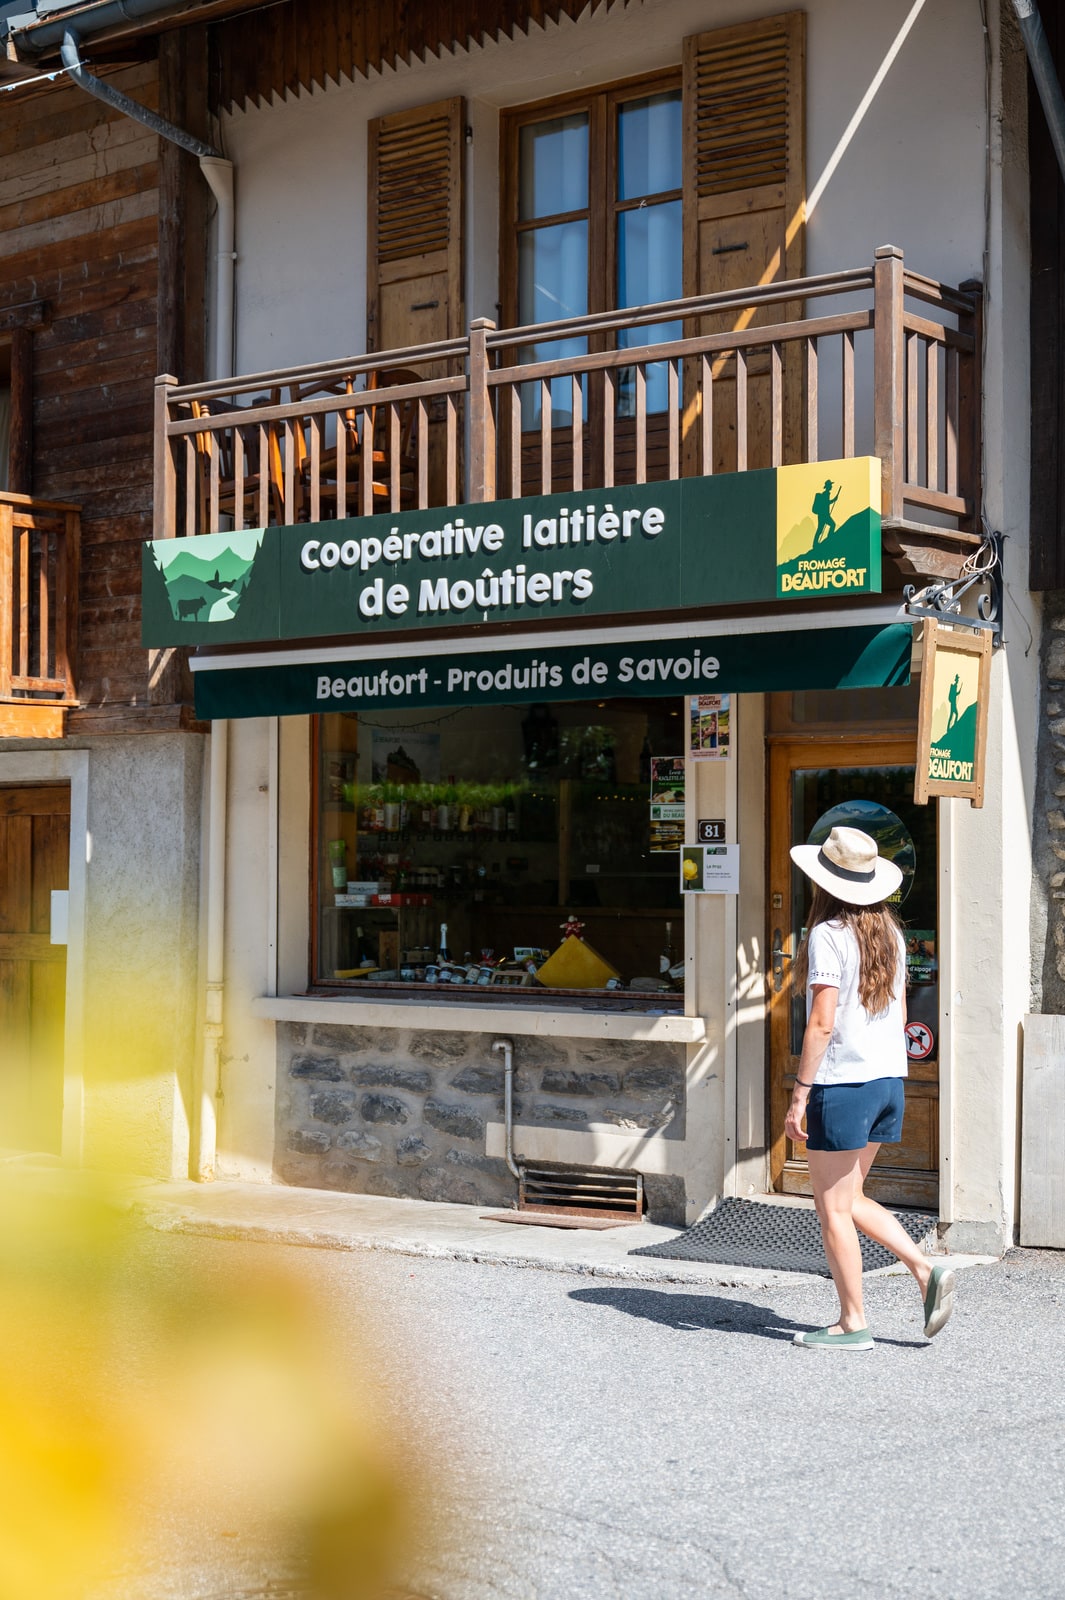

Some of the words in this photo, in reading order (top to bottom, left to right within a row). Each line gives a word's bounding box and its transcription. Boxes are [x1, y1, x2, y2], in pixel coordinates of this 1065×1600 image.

[301, 519, 504, 570] Coopérative
[523, 504, 665, 547] laitière
[781, 568, 867, 592] BEAUFORT
[798, 557, 846, 571] FROMAGE
[359, 578, 409, 616] de
[418, 565, 593, 611] Moûtiers
[316, 668, 428, 699] Beaufort
[447, 659, 563, 692] Produits
[571, 657, 609, 684] de
[617, 649, 720, 683] Savoie
[705, 824, 719, 838] 81
